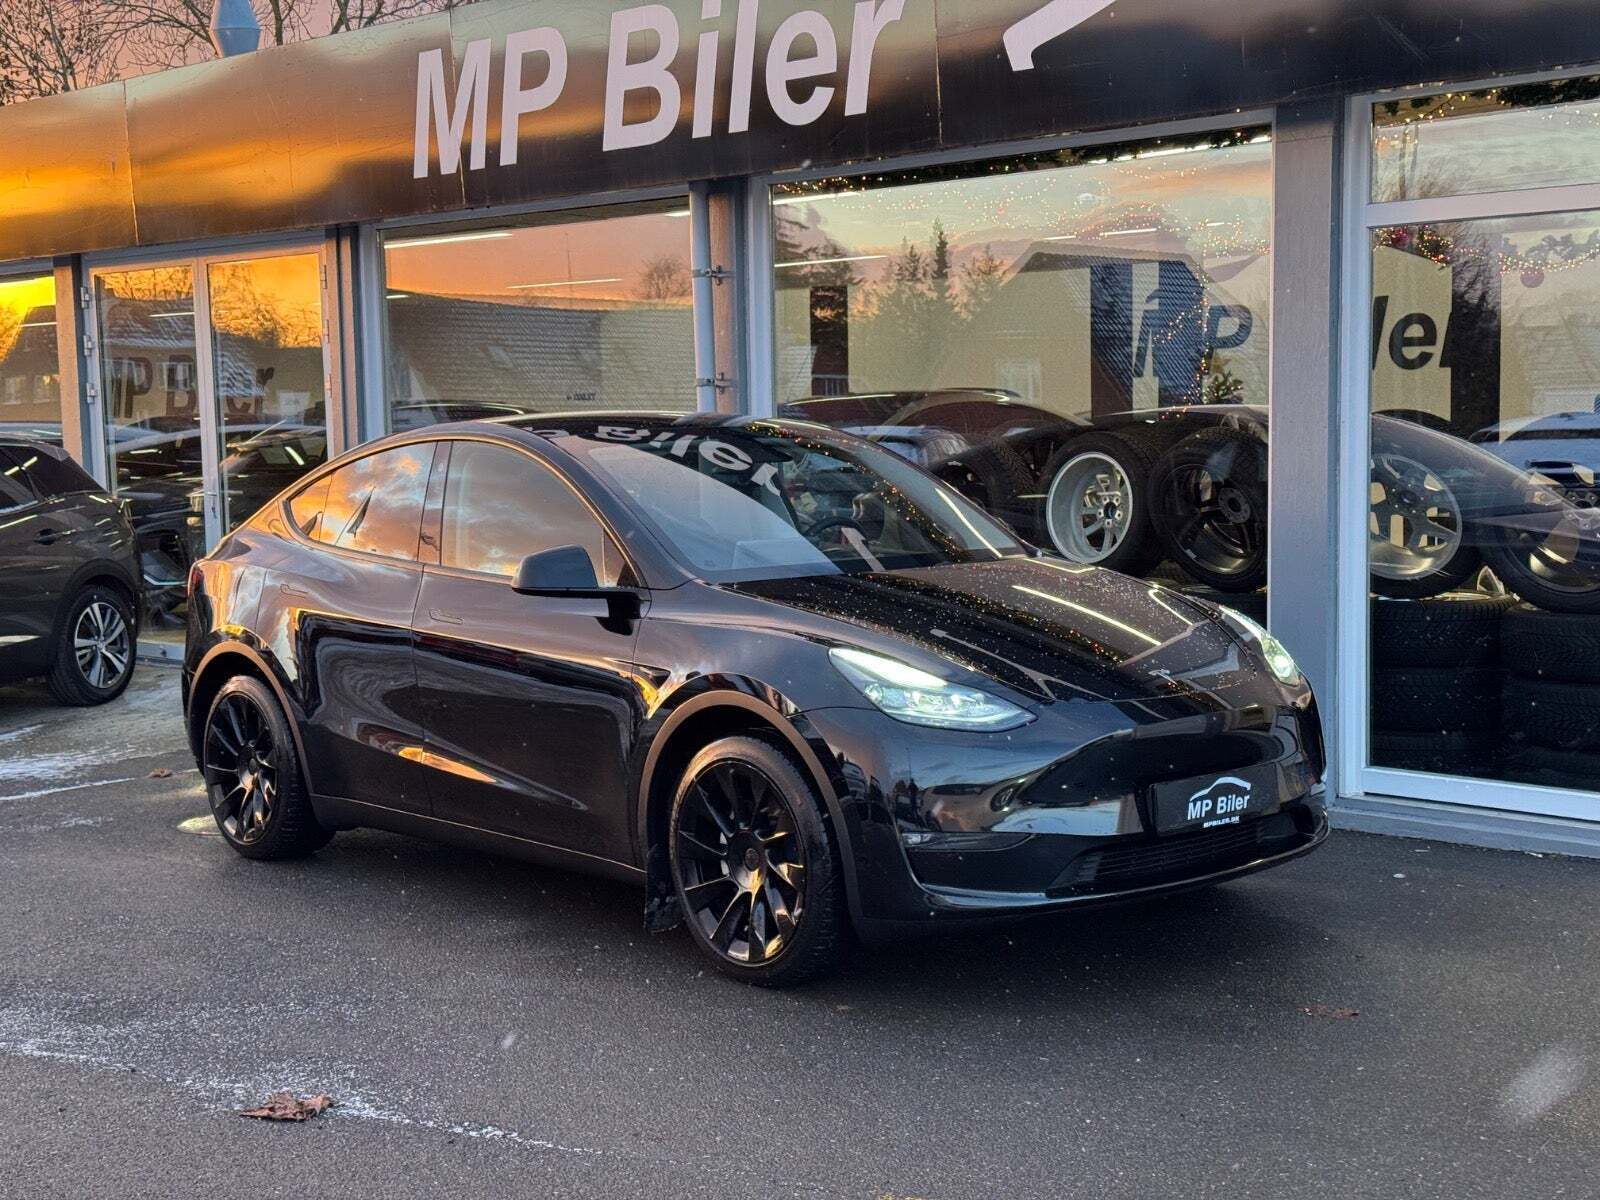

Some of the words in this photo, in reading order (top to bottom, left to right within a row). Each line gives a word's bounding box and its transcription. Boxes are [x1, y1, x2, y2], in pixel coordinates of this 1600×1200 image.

[412, 26, 568, 180] MP
[602, 0, 902, 152] Biler
[1187, 800, 1213, 820] MP
[1216, 794, 1250, 815] Biler
